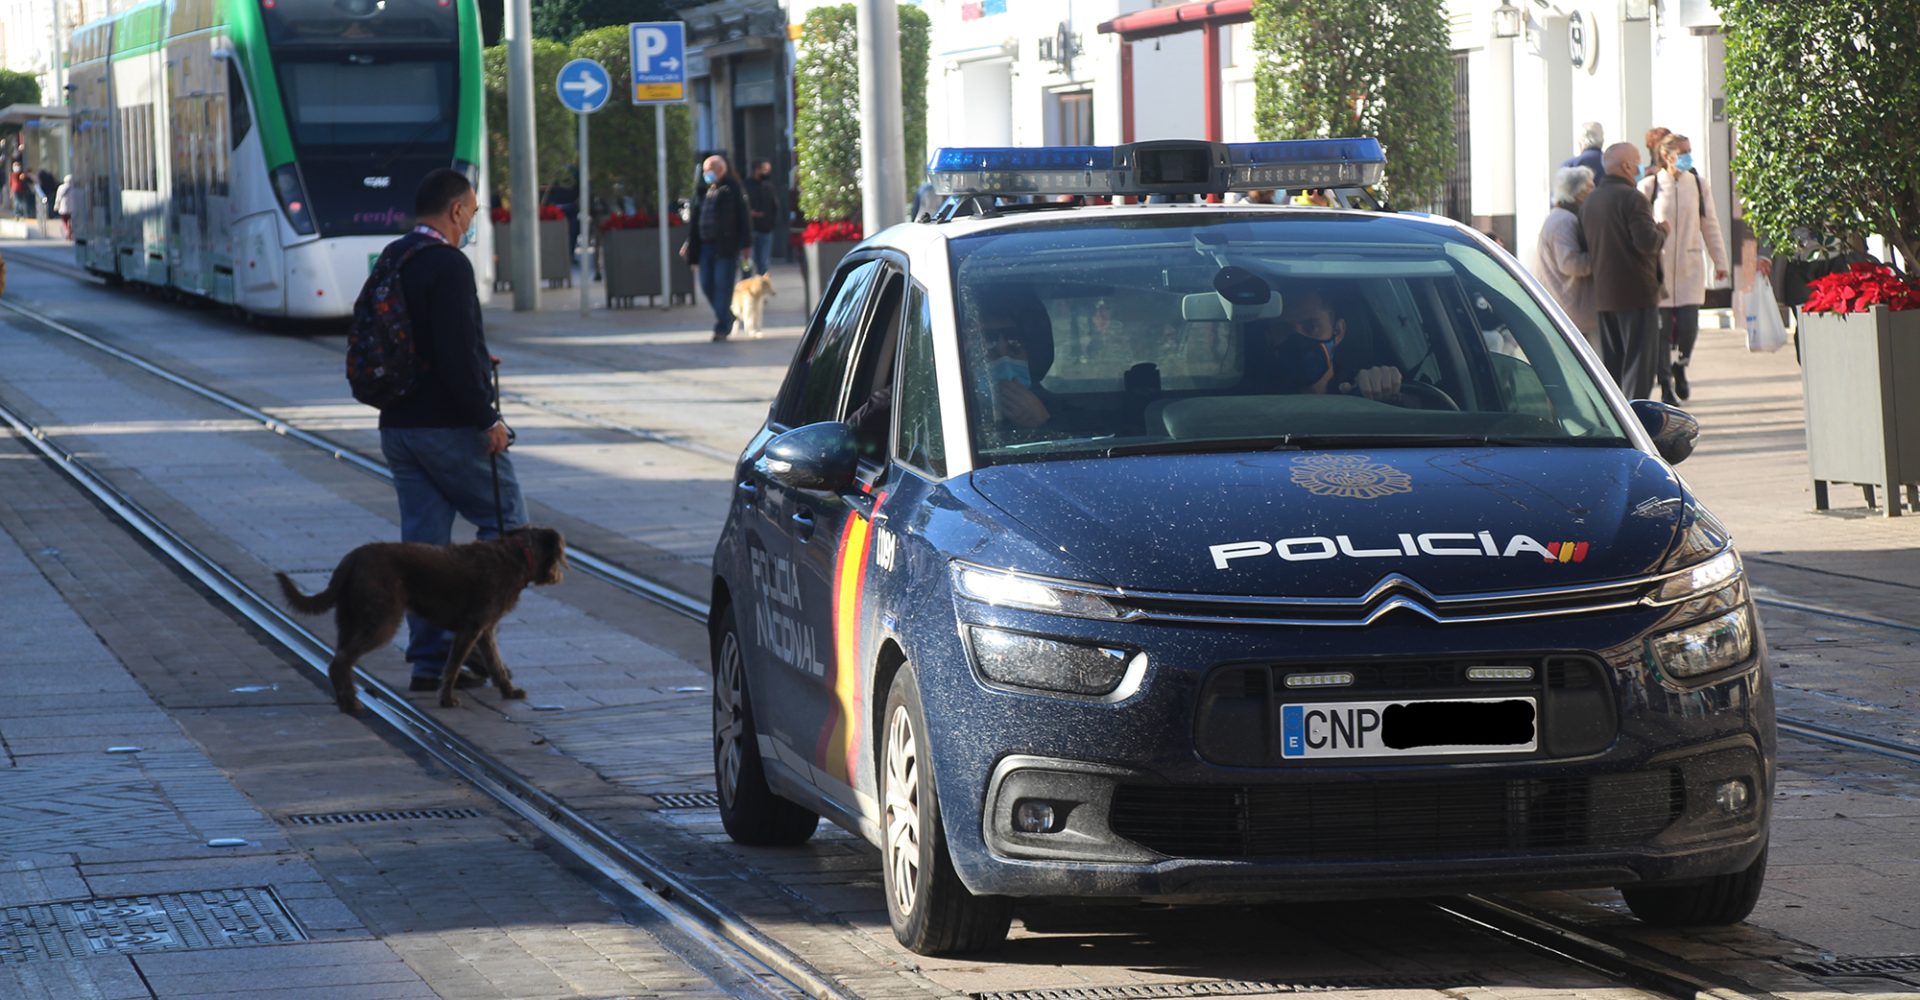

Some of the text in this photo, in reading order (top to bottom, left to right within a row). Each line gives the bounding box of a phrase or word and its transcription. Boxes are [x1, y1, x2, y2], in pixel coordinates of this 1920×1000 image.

[636, 27, 667, 73] P
[353, 207, 406, 226] renfe
[1208, 530, 1558, 570] POLICÍA
[1289, 737, 1298, 748] E
[1304, 708, 1380, 750] CNP
